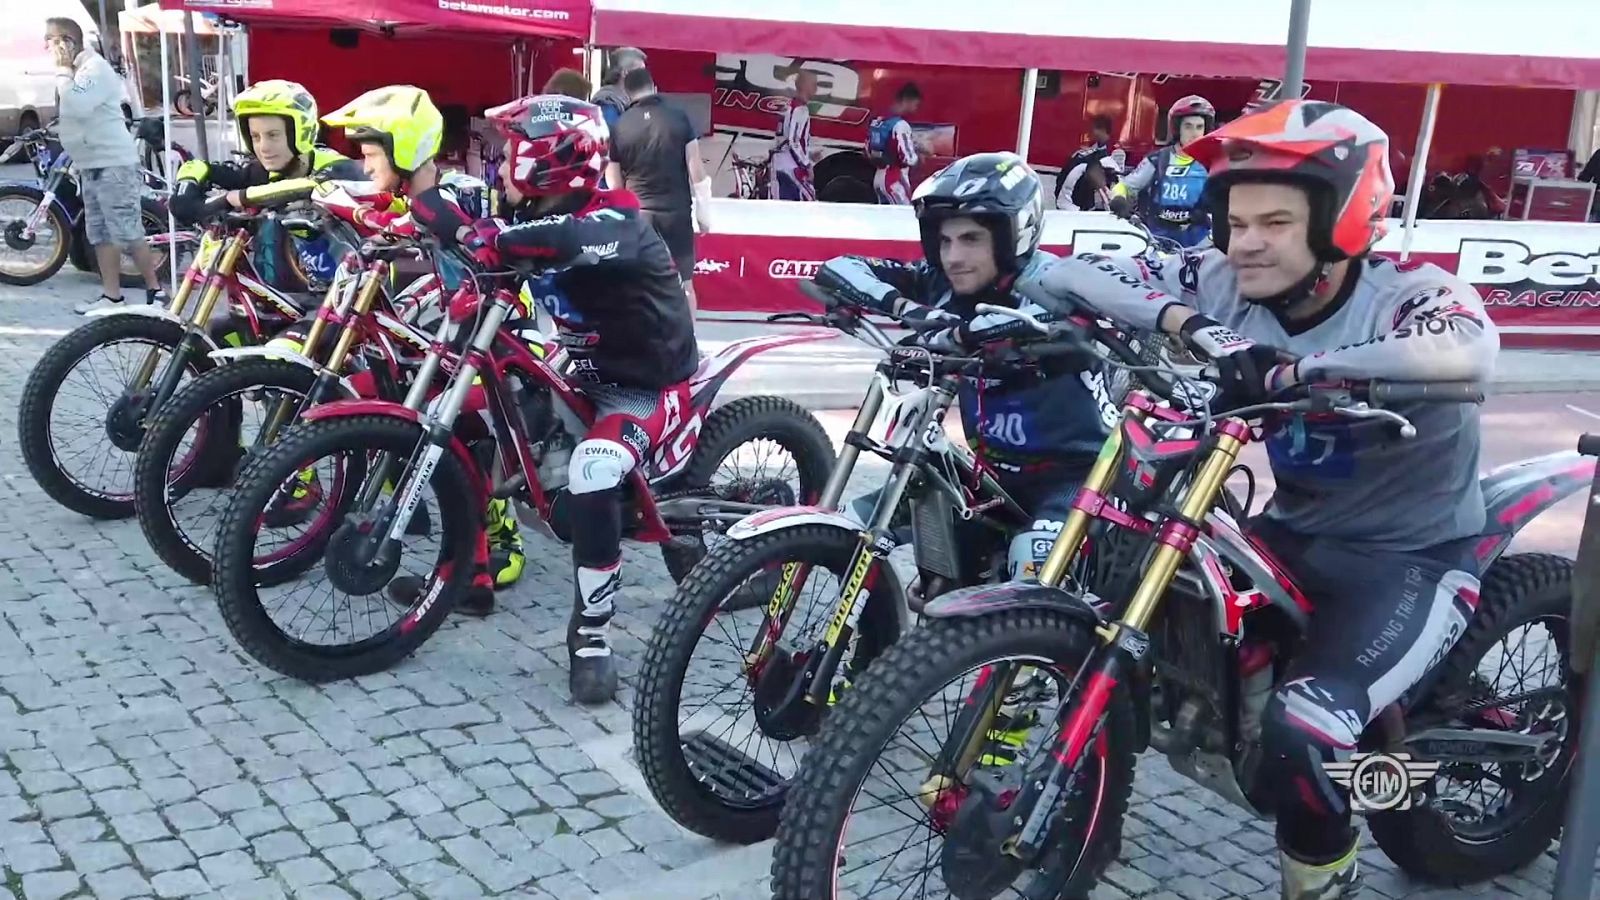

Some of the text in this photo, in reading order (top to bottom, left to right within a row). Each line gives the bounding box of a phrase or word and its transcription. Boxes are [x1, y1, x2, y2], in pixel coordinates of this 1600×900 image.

[438, 0, 570, 20] betamotor.com
[531, 112, 571, 123] CONCEPT
[1161, 182, 1188, 200] 284
[408, 460, 434, 512] MICHELIN
[832, 552, 868, 628] DUNLOP
[1355, 619, 1405, 669] RACING
[1394, 589, 1420, 620] TRIAL
